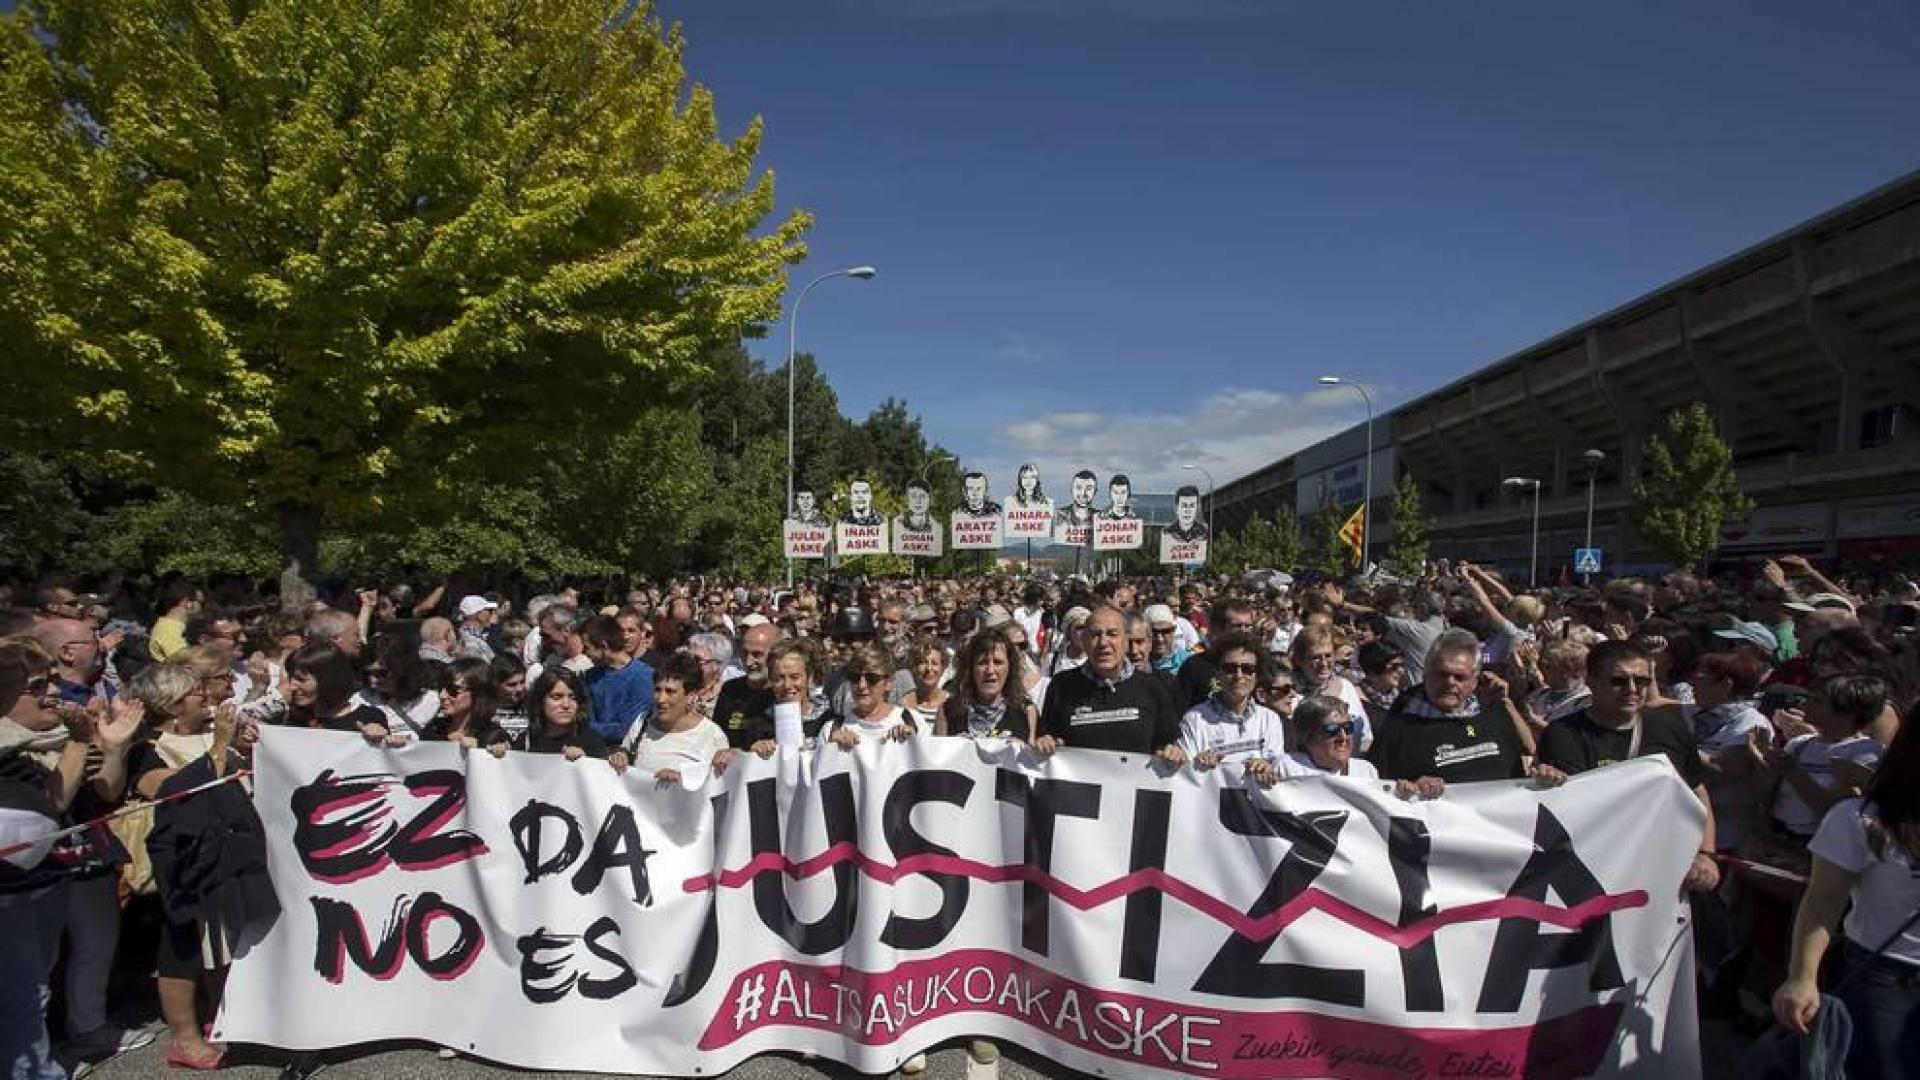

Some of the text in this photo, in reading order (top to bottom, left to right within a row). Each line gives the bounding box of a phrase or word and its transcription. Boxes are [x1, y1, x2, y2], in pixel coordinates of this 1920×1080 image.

[1008, 511, 1052, 520] AINARA
[955, 521, 996, 532] ARATZ
[1014, 522, 1044, 531] ASKE
[1096, 522, 1139, 532] JONAN
[788, 531, 825, 541] JULEN
[959, 534, 992, 544] ASKE
[1101, 534, 1133, 544] ASKE
[792, 543, 822, 553] ASKE
[846, 539, 880, 549] ASKE
[902, 543, 930, 551] ASKE
[1171, 552, 1197, 560] ASKE
[290, 768, 656, 907] EZ DA
[662, 769, 1627, 1014] JUSTIZIA
[310, 892, 637, 1004] NO ES
